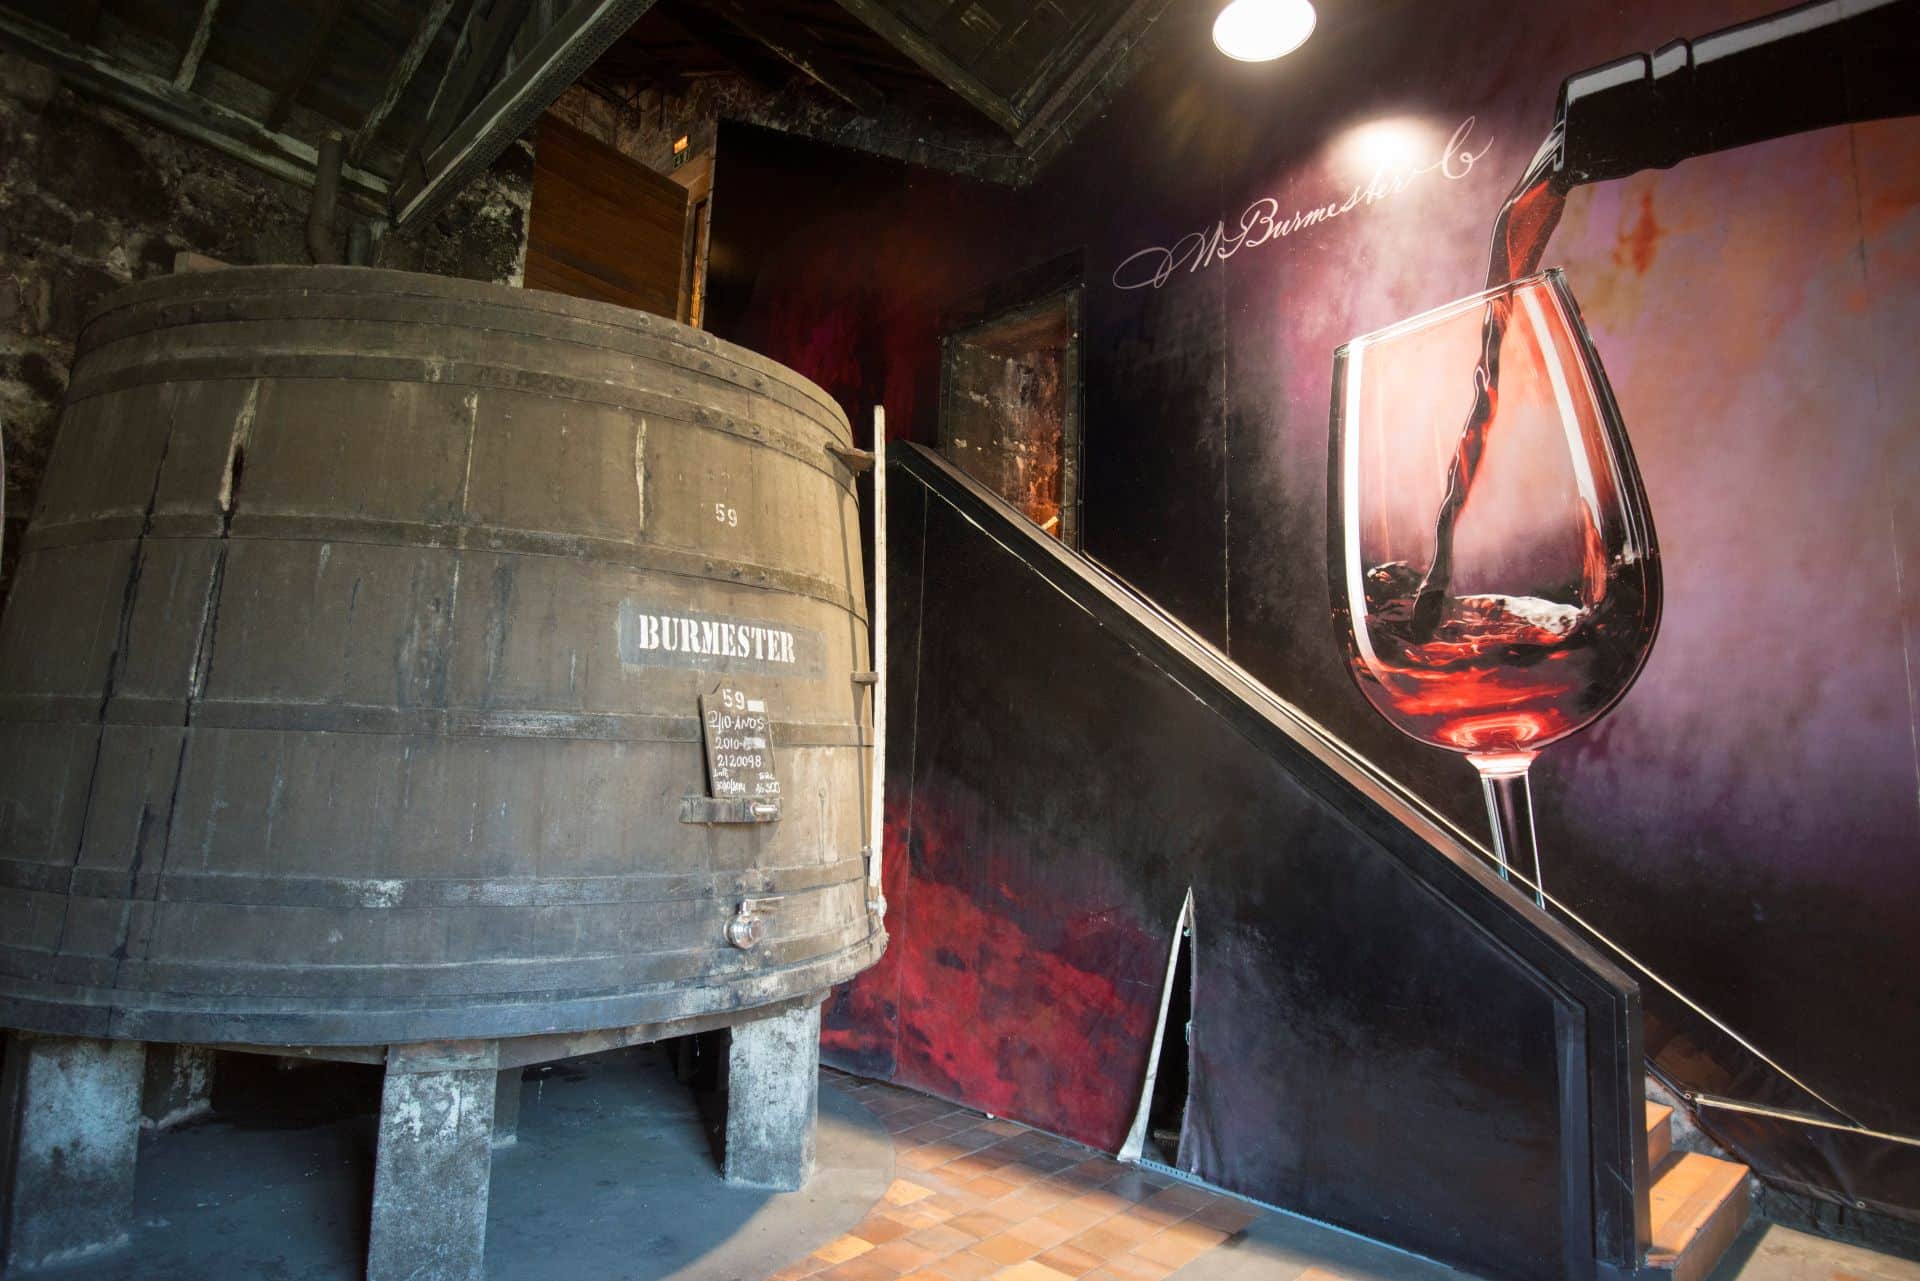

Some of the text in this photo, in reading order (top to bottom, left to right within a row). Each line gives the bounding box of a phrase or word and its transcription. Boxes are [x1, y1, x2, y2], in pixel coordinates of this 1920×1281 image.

[715, 503, 738, 527] 59
[639, 614, 796, 663] BURMESTER
[722, 688, 746, 710] 59
[717, 753, 762, 769] 2120098
